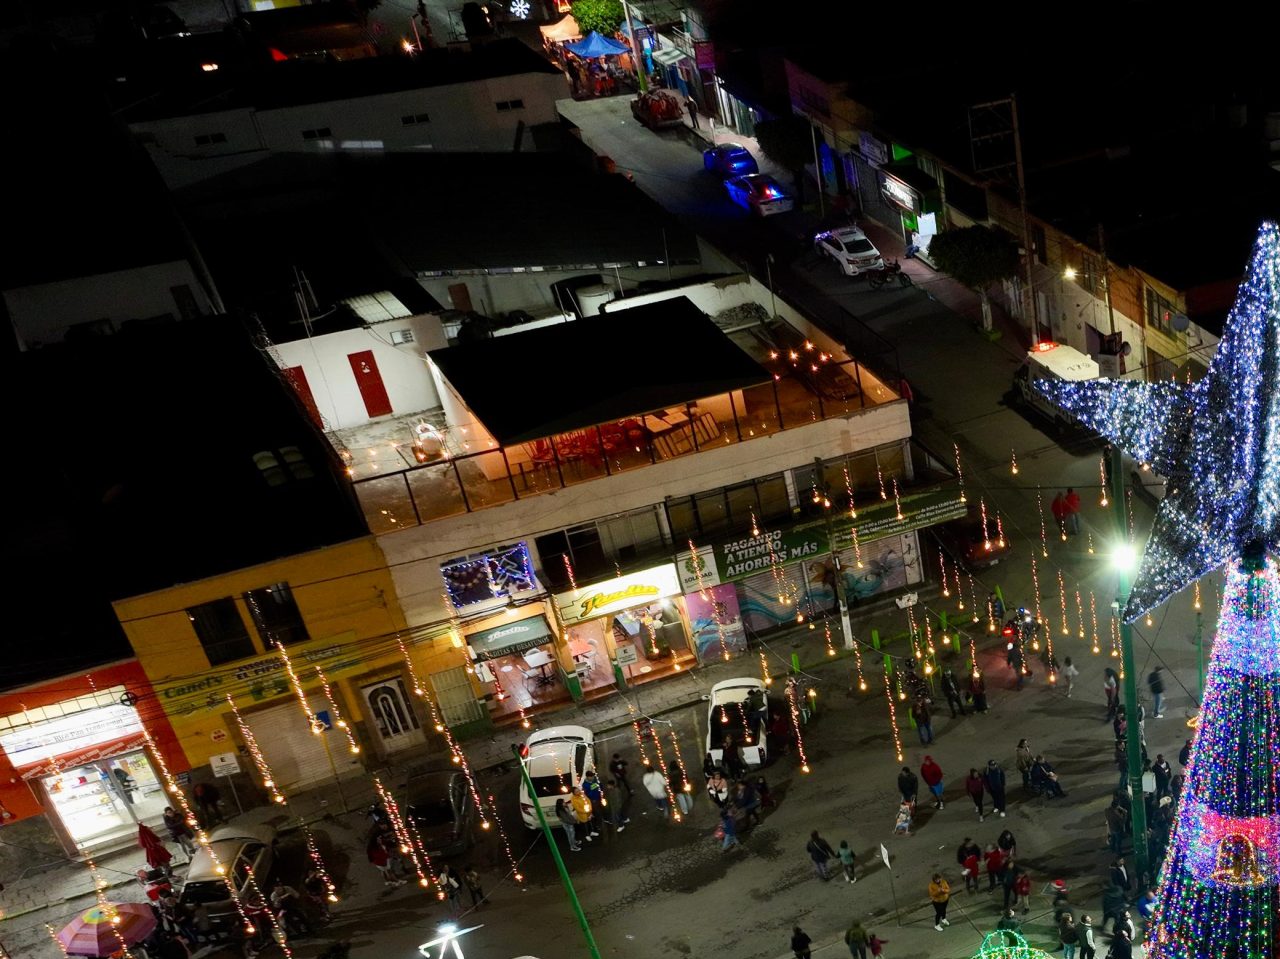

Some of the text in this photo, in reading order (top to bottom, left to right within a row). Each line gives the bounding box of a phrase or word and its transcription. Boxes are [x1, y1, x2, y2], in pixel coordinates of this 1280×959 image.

[723, 530, 782, 554] PAGANDO
[726, 541, 788, 565] A TIEMPO,
[726, 543, 818, 578] AHORRAS MÁS
[479, 646, 510, 661] GDITAS
